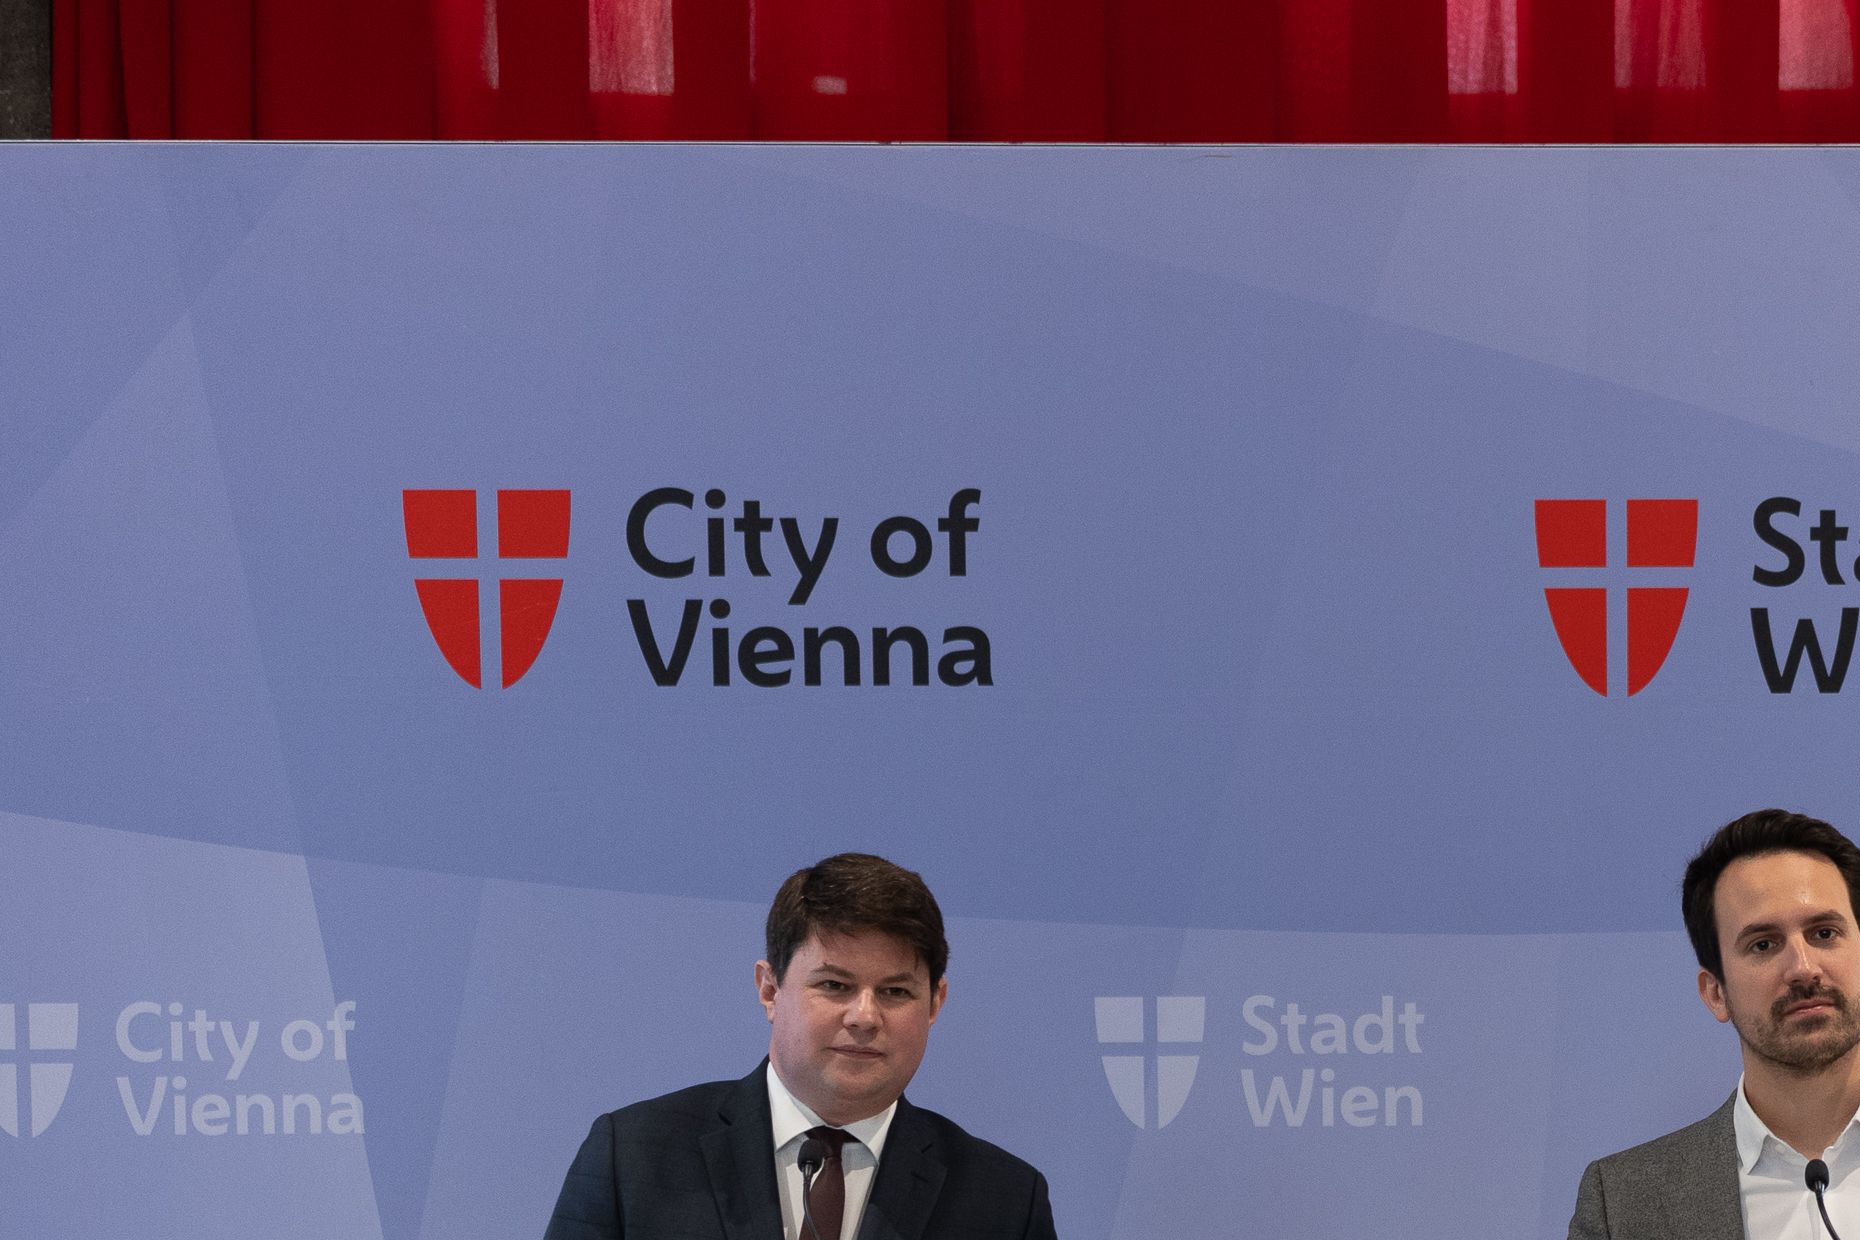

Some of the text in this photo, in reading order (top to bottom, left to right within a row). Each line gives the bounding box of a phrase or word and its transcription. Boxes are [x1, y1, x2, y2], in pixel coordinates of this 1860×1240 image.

[626, 487, 981, 605] City of
[626, 599, 994, 688] Vienna
[116, 1001, 356, 1080] City of
[1242, 995, 1425, 1055] Stadt
[116, 1076, 365, 1135] Vienna
[1241, 1068, 1423, 1127] Wien
